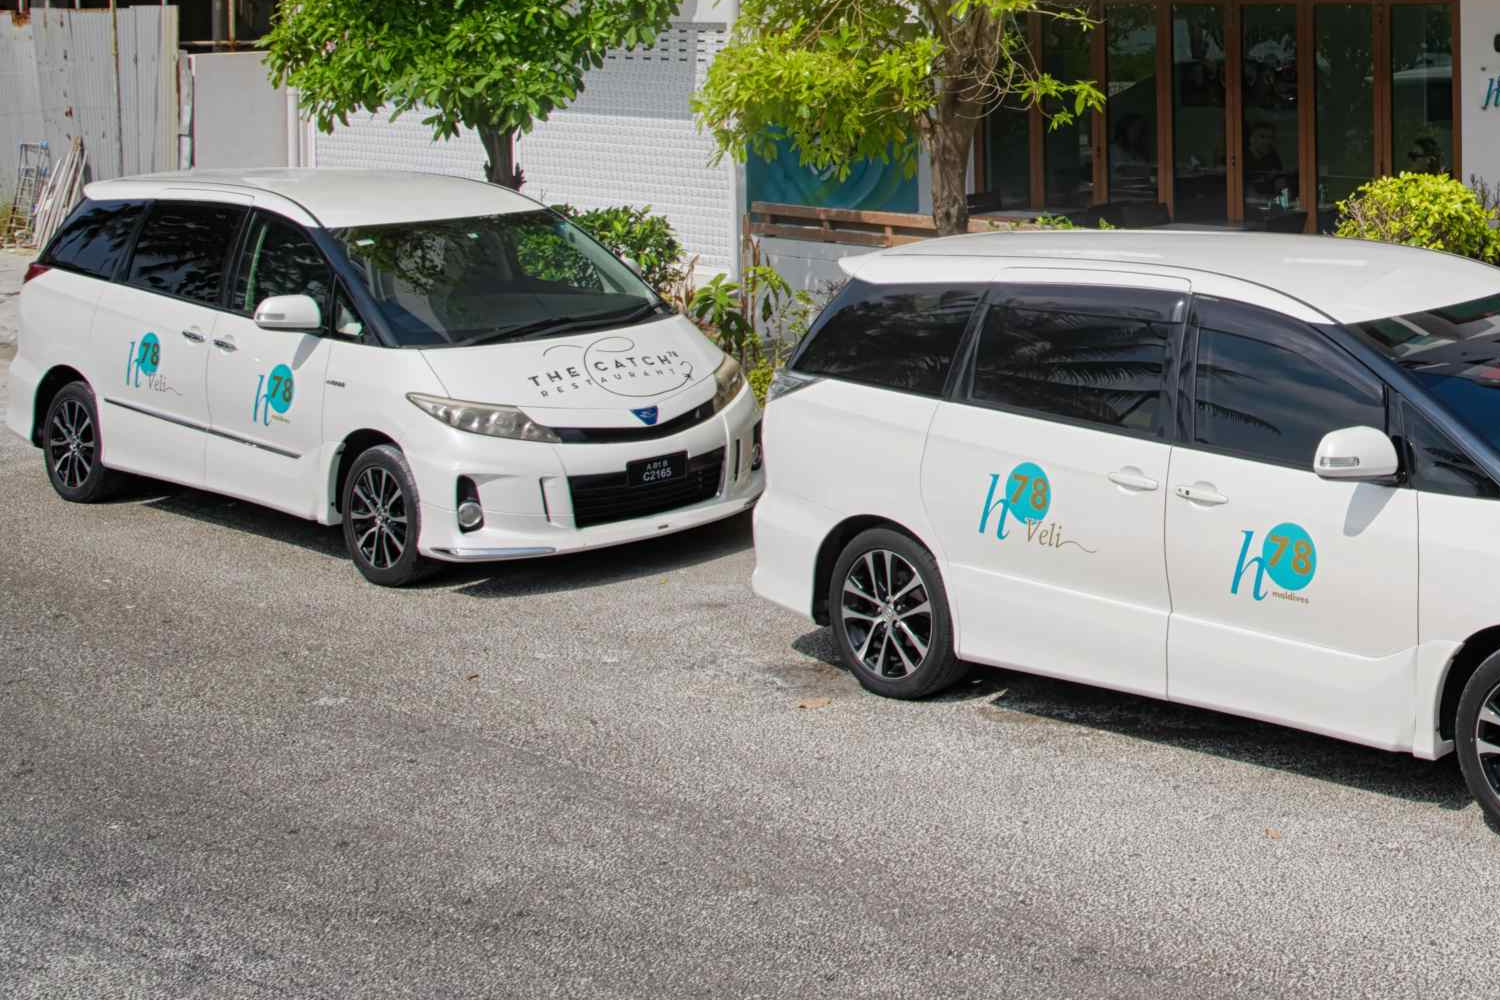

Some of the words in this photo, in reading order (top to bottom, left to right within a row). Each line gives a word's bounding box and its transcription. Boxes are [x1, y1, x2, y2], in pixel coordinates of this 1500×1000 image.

[528, 366, 581, 387] THE
[593, 355, 673, 372] CATCH
[540, 368, 677, 398] RESTAURANT
[642, 467, 672, 481] C2165
